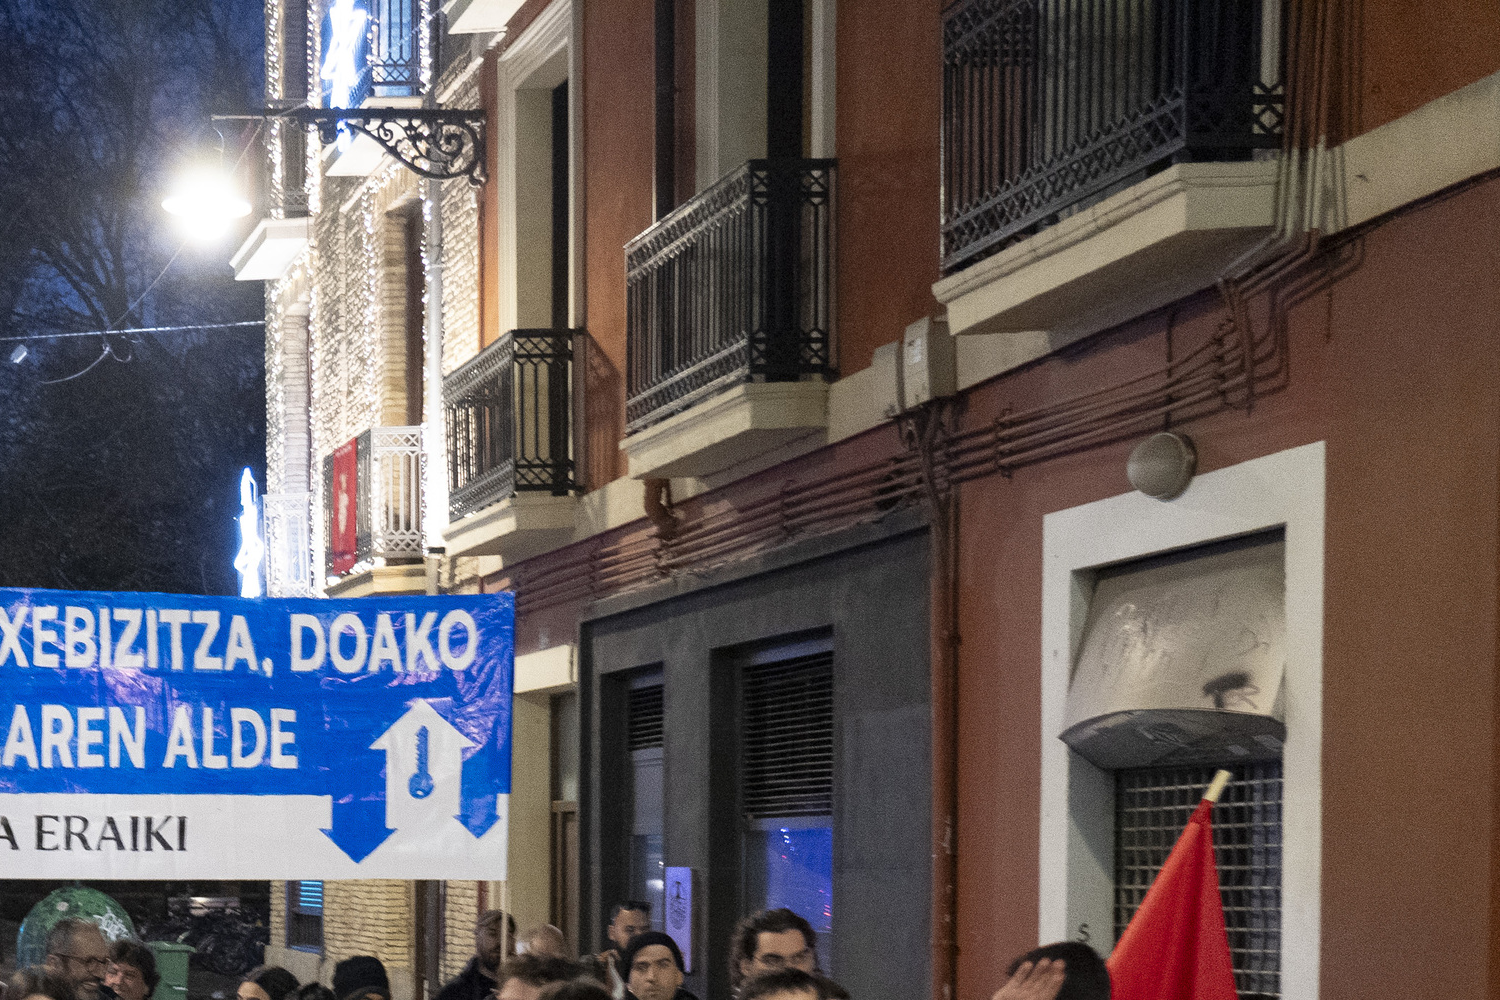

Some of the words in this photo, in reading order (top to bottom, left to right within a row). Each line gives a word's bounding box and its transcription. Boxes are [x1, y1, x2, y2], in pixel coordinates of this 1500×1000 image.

[290, 609, 478, 673] DOAKO
[162, 704, 298, 769] ALDE
[34, 815, 188, 852] ERAIKI
